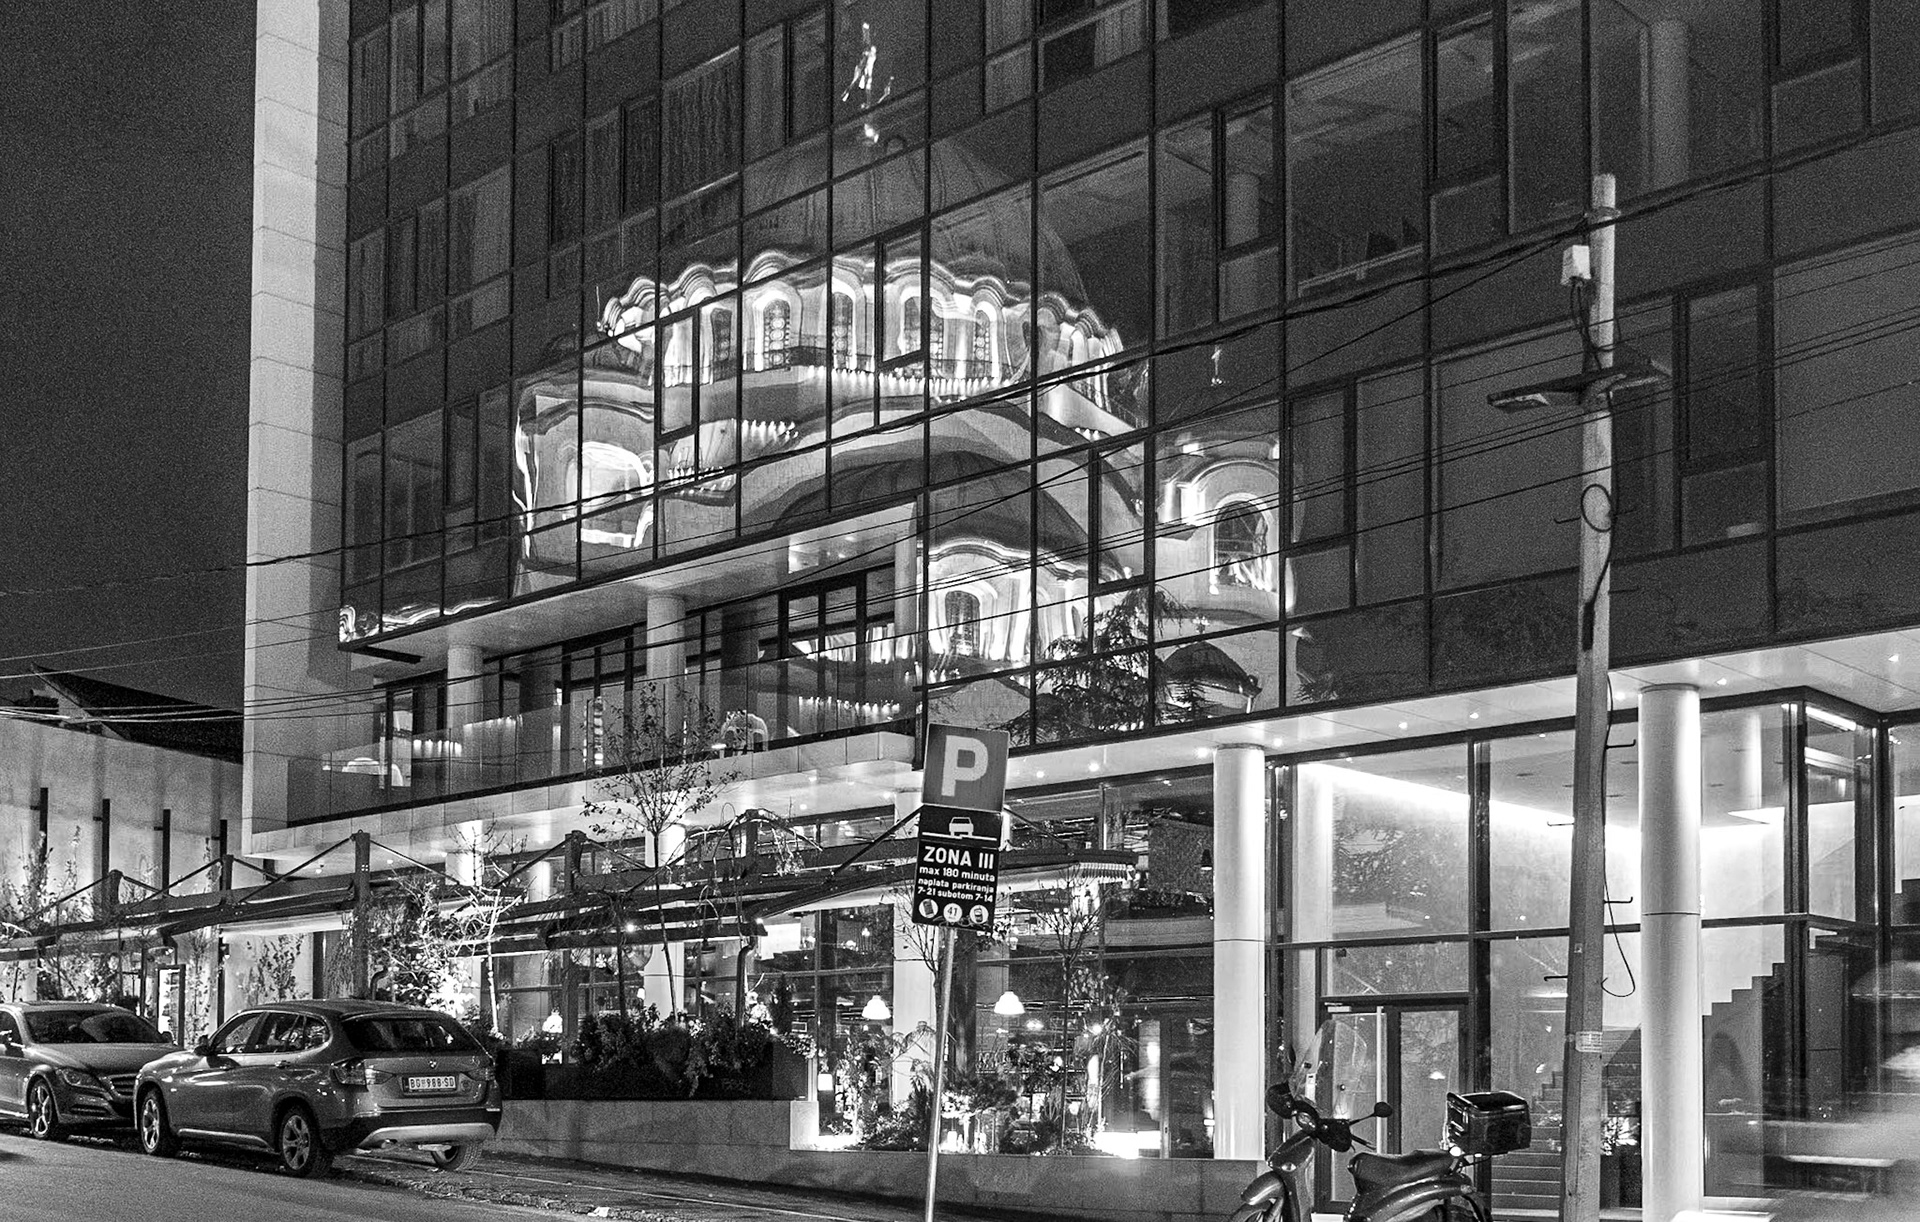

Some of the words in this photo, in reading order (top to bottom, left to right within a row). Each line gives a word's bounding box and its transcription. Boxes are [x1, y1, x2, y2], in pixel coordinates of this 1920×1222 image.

[941, 734, 989, 797] P
[923, 845, 972, 867] ZONA
[978, 852, 994, 870] III
[919, 866, 940, 875] max
[942, 867, 959, 877] 180
[961, 871, 995, 882] minuta
[917, 878, 950, 888] naplata
[952, 882, 995, 894] parkiranja
[917, 886, 936, 896] 7-21
[937, 890, 974, 900] subotom
[975, 893, 993, 903] 7-14
[947, 906, 958, 917] 41
